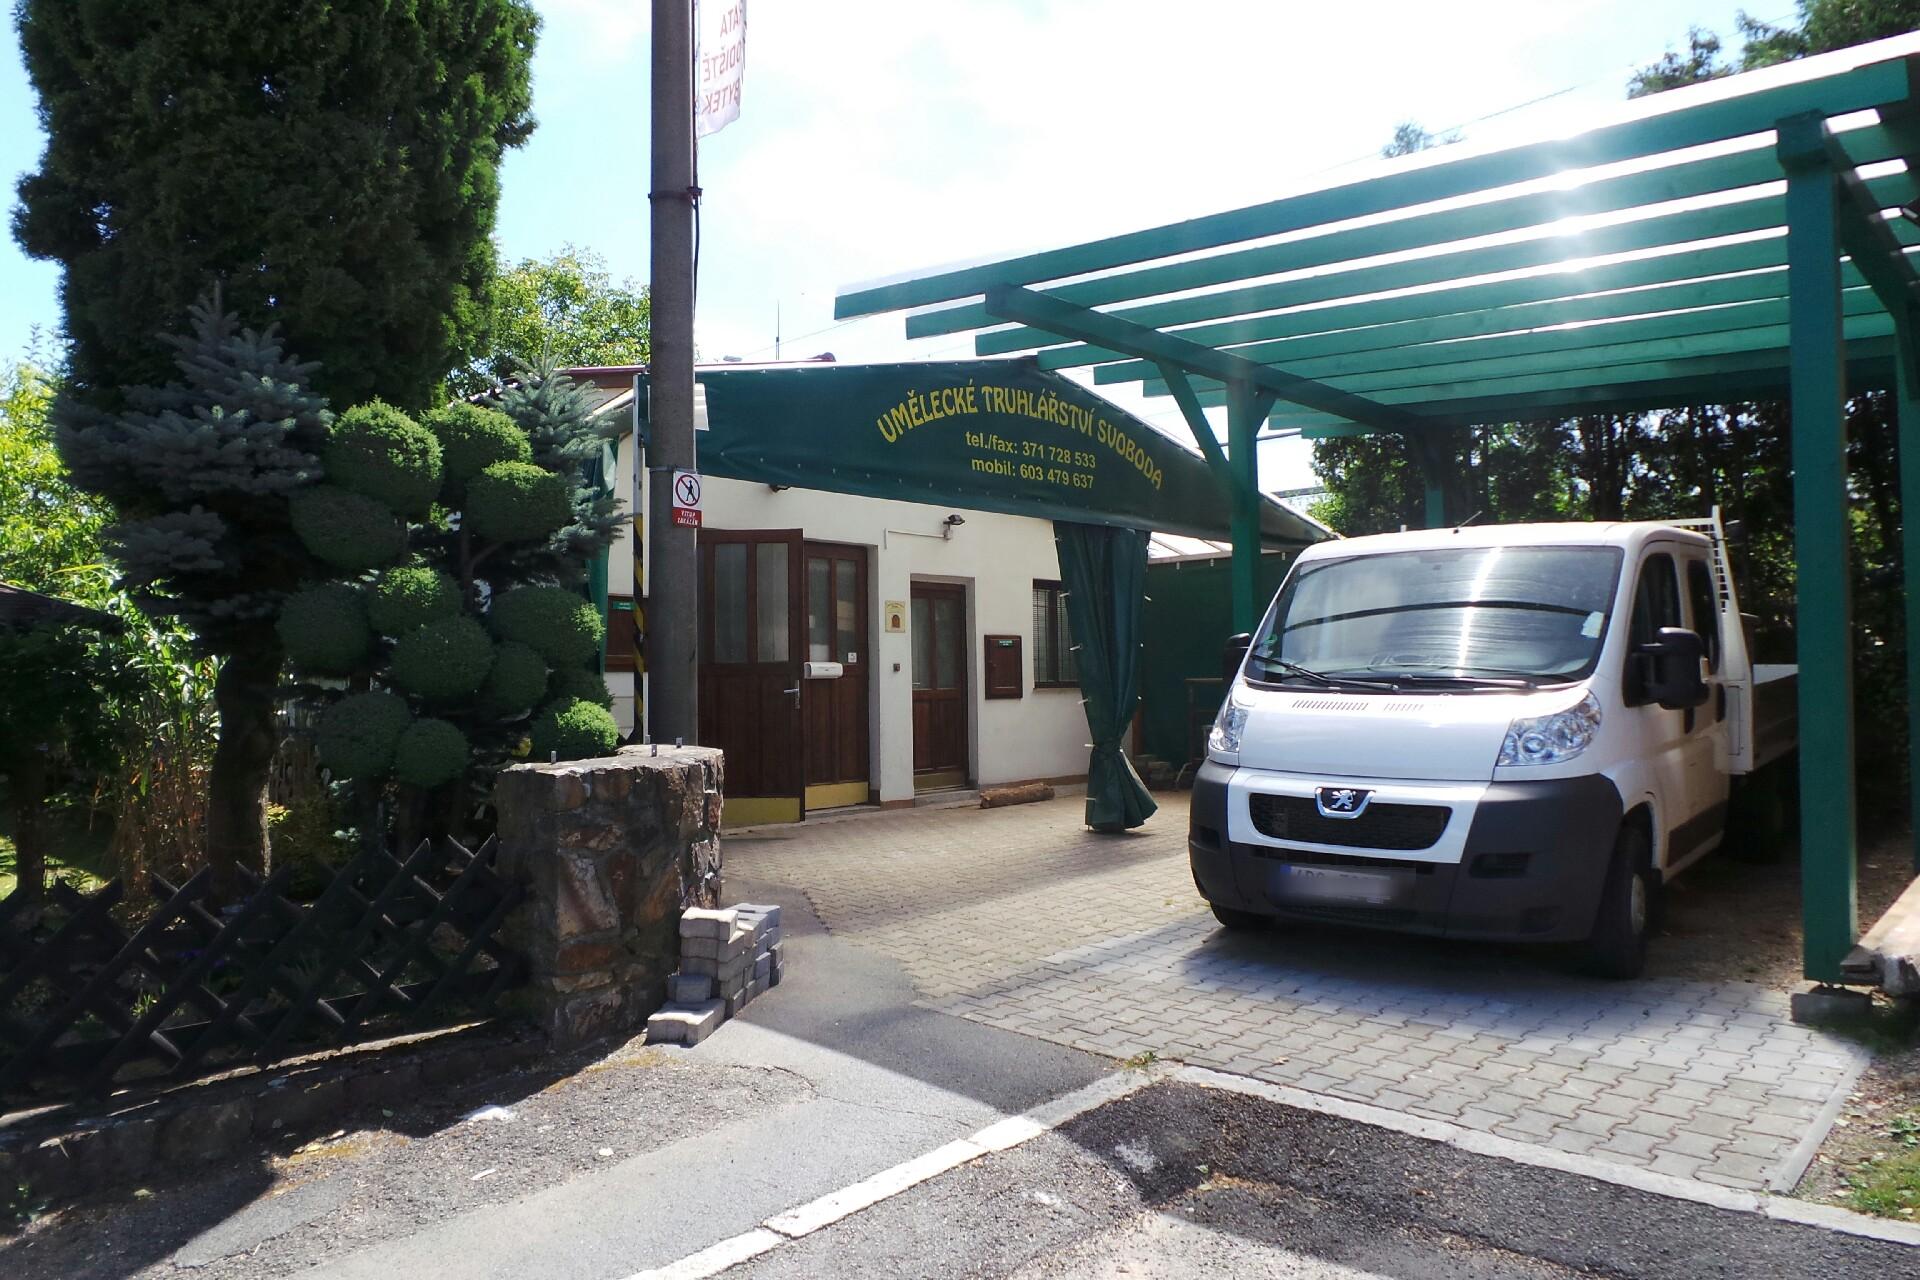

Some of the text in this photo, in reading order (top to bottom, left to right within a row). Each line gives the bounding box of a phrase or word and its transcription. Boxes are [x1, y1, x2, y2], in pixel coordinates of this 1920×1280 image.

[876, 379, 1164, 491] UMĚLECKÉ TRUHLÁŘSTVÍ SVOBODA
[965, 431, 1096, 469] tel./fax: 371 728 533
[971, 457, 1094, 489] mobil: 603 479 637
